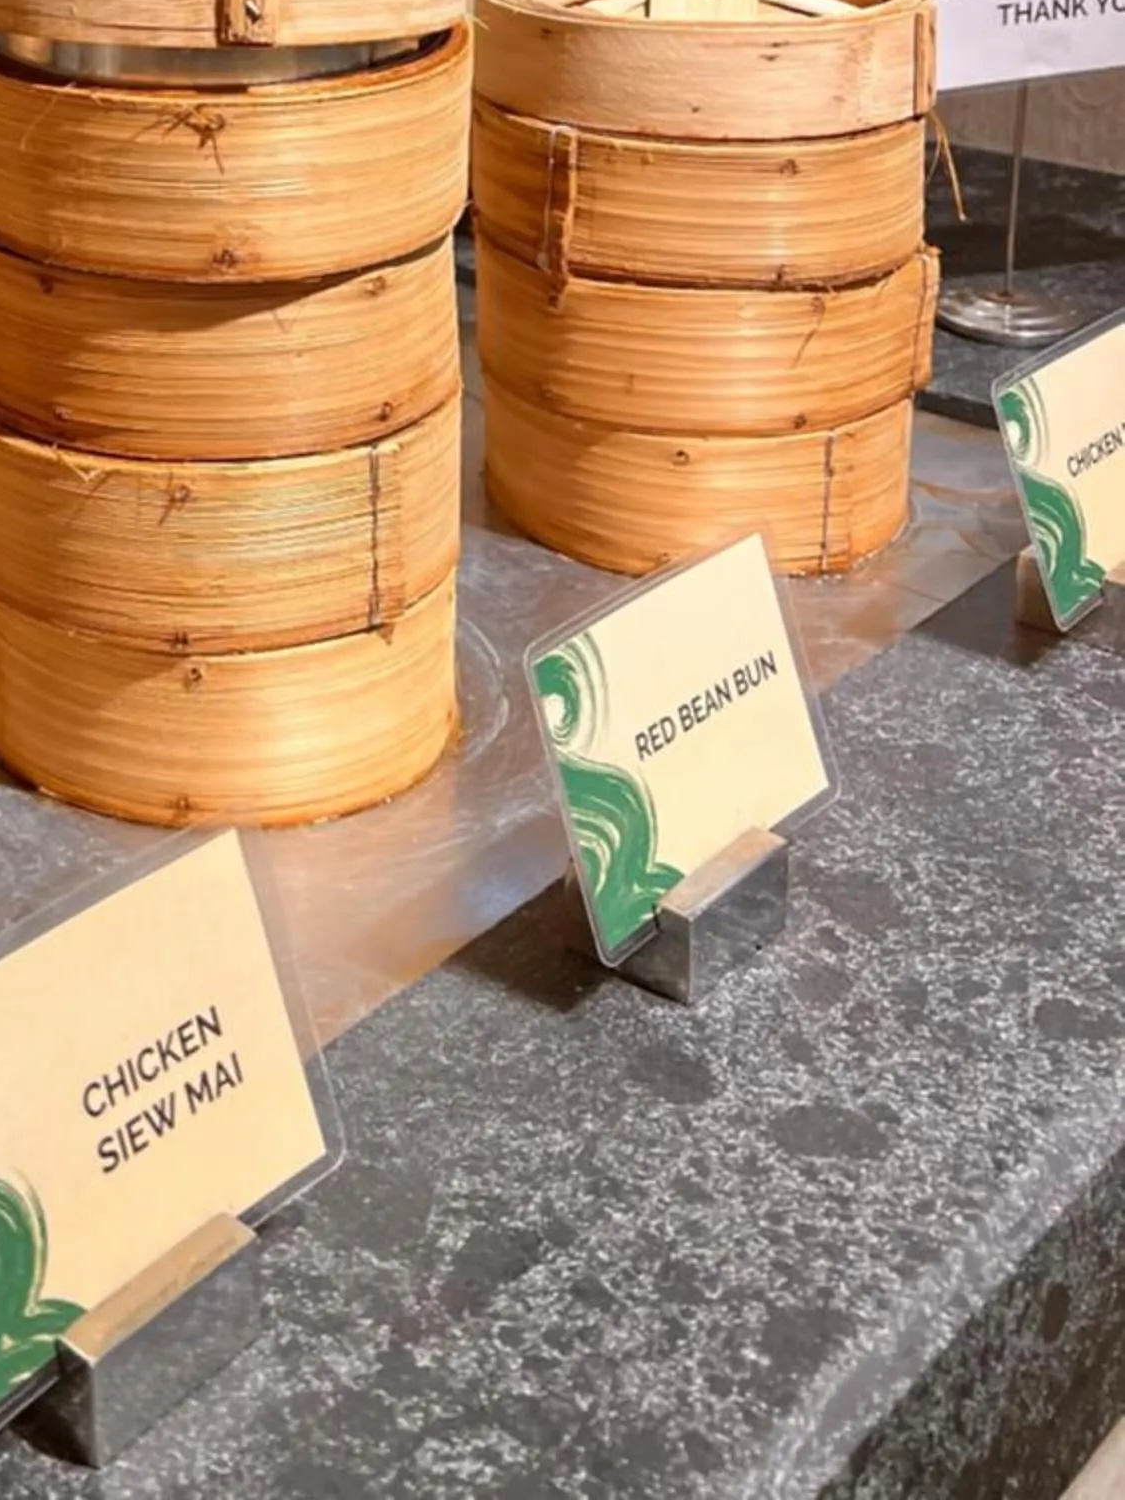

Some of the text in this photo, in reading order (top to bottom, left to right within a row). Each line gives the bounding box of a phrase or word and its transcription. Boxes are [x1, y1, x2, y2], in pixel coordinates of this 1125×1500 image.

[1066, 425, 1123, 478] CHICKEN
[634, 649, 778, 762] RED BEAN BUN
[81, 1004, 223, 1118] CHICKEN
[97, 1051, 244, 1174] SIEW MAI
